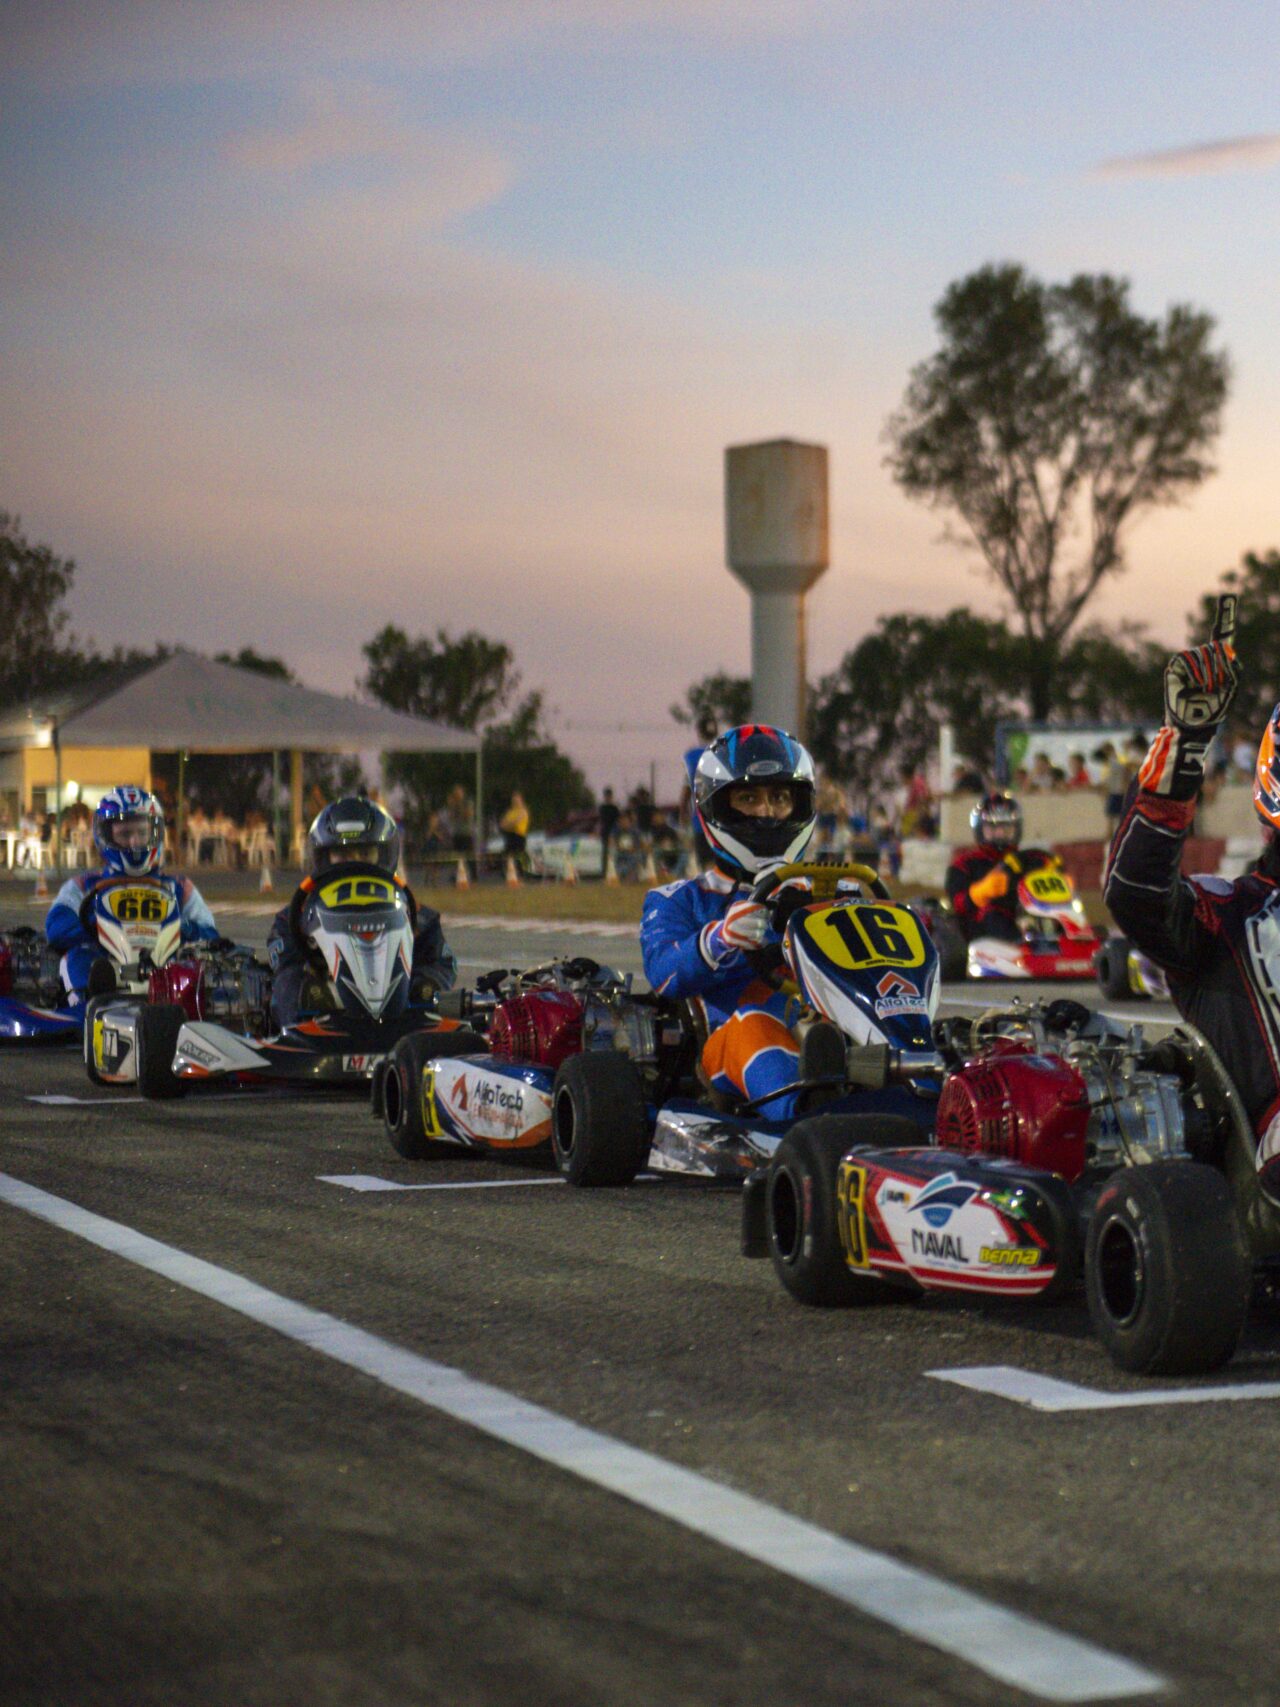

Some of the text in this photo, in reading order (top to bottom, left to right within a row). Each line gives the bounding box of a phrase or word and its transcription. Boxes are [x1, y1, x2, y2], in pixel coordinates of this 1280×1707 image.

[118, 898, 161, 919] 66
[825, 907, 914, 963] 16
[911, 1228, 969, 1264] NAVAL
